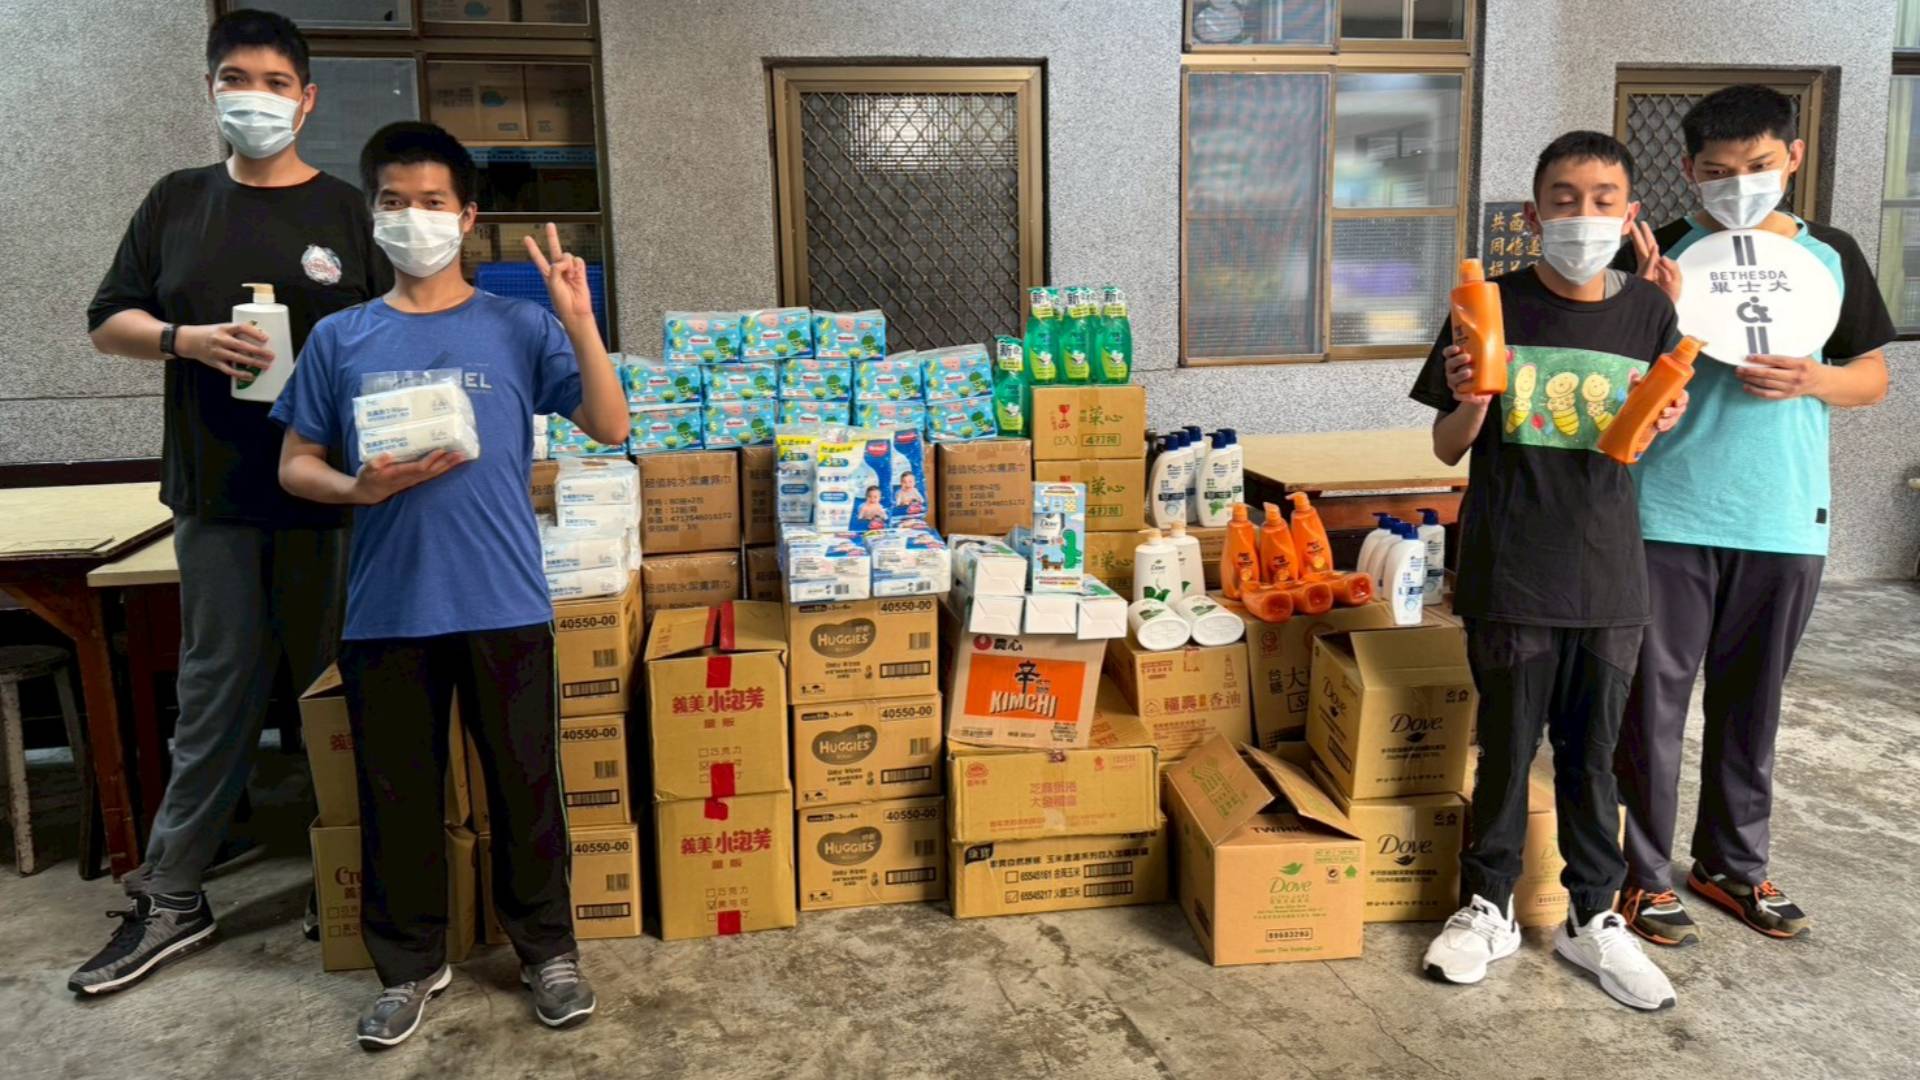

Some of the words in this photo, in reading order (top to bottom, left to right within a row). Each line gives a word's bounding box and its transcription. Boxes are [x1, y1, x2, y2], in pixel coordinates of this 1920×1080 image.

[1709, 270, 1788, 281] BETHESDA
[1709, 281, 1792, 294] 畢士大
[464, 372, 492, 389] EL
[881, 600, 932, 612] 40550-00
[560, 615, 616, 629] 40550-00
[817, 631, 870, 647] HUGGIES
[1014, 659, 1041, 694] 辛
[672, 694, 705, 714] 義美
[707, 686, 765, 714] 小泡芙
[989, 689, 1059, 719] KIMCHI
[882, 706, 933, 718] 40550-00
[1389, 713, 1443, 733] Dove
[562, 727, 617, 740] 40550-00
[819, 739, 873, 754] HUGGIES
[886, 808, 936, 821] 40550-00
[574, 841, 630, 853] 40550-00
[681, 836, 713, 855] 義美
[714, 827, 772, 854] 小泡芙
[825, 841, 877, 855] HUGGIES
[1376, 833, 1433, 855] Dove
[1269, 876, 1313, 894] Dove
